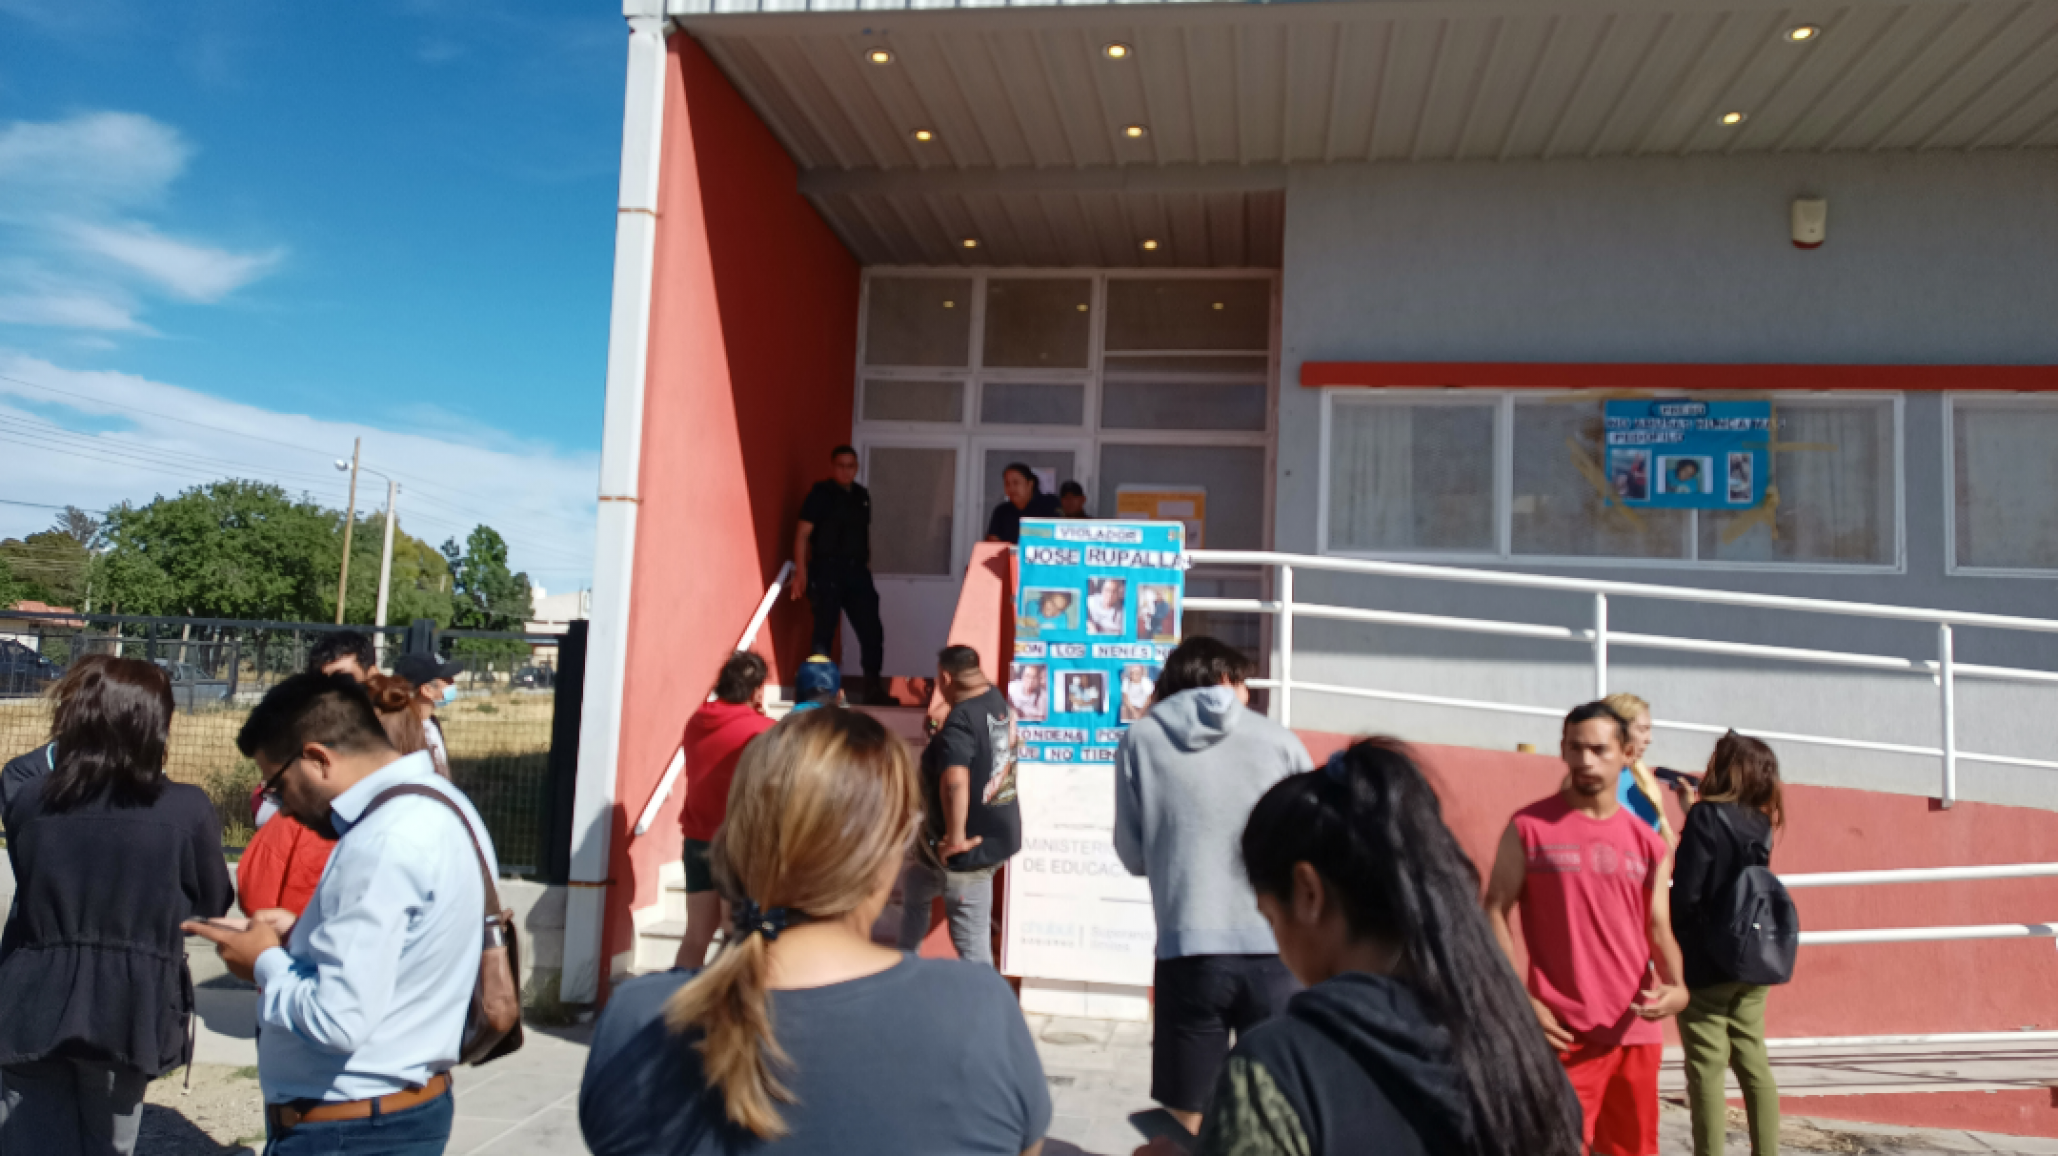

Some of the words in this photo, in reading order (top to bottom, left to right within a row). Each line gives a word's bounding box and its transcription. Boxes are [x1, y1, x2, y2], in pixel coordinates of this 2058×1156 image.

[1060, 527, 1137, 541] VIOLADOR
[1026, 547, 1077, 564] JOSE
[1056, 645, 1085, 657] LOS
[1018, 747, 1037, 758] UE
[1051, 749, 1074, 761] NO
[1083, 749, 1116, 761] TIEN
[1023, 857, 1047, 873] DE
